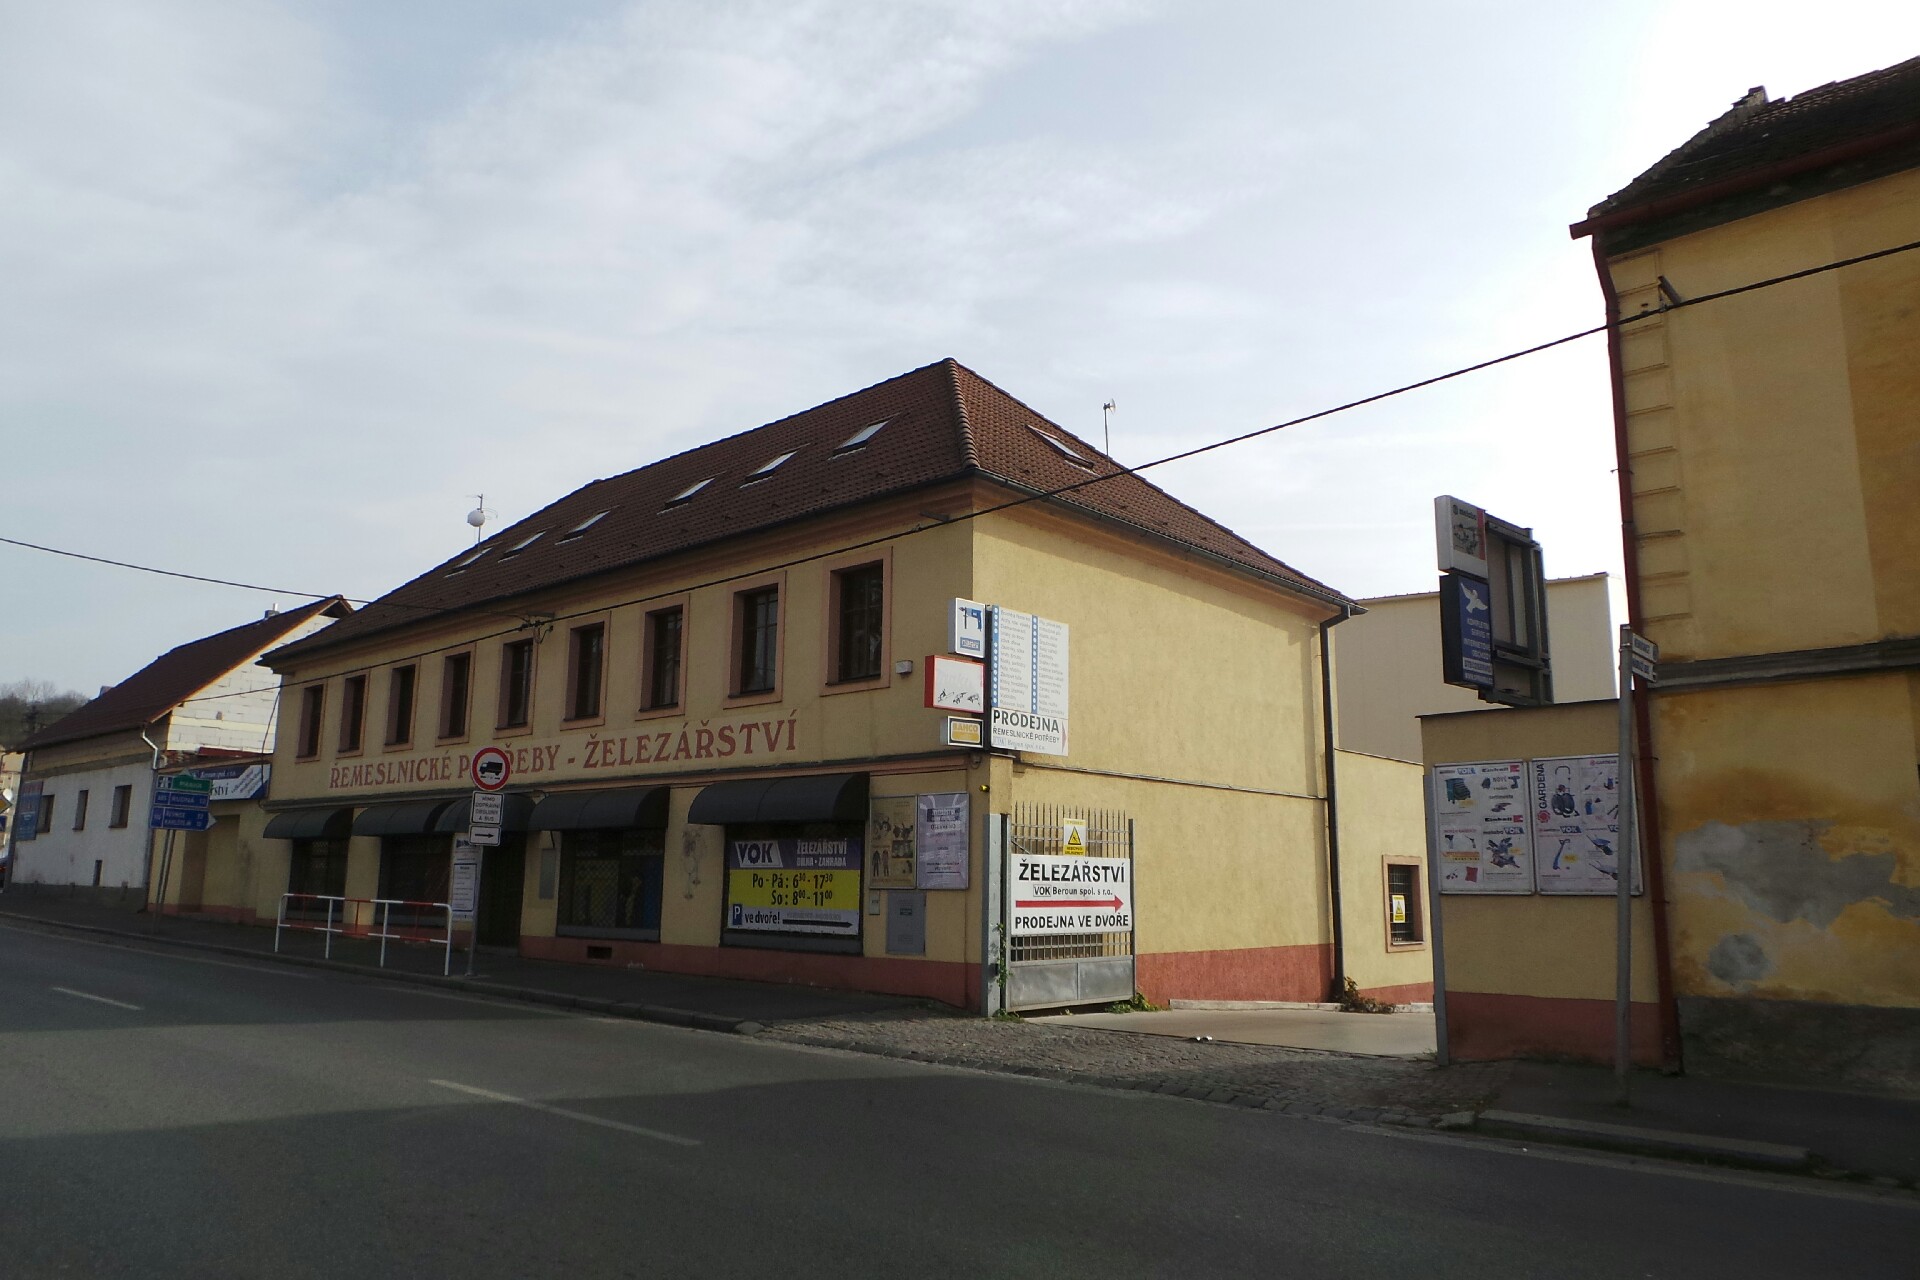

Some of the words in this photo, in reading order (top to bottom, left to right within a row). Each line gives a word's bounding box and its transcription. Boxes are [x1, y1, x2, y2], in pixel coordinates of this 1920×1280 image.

[993, 709, 1060, 733] PRODEJNA
[993, 725, 1034, 740] ŘEMESLNICKÉ
[1034, 732, 1060, 744] POTŘEBY
[329, 751, 451, 789] ŘEMESLNICKÉ
[583, 709, 797, 769] ŽELEZÁŘSTVÍ
[1537, 763, 1548, 809] GARDENA
[739, 842, 774, 865] VOK
[796, 838, 848, 855] ŽELEZÁŘSTVÍ
[818, 856, 847, 867] ZAHRADA
[1018, 858, 1125, 883] ŽELEZÁŘSTVÍ
[752, 873, 764, 888] Po
[1034, 886, 1051, 896] VOK
[1052, 886, 1078, 896] Beroun
[1079, 887, 1096, 897] spol.
[1102, 888, 1113, 896] r.o.
[744, 912, 754, 924] ve
[754, 911, 780, 924] dvoře!
[1015, 915, 1075, 929] PRODEJNA
[1077, 914, 1092, 928] VE
[1095, 912, 1129, 927] DVOŘE
